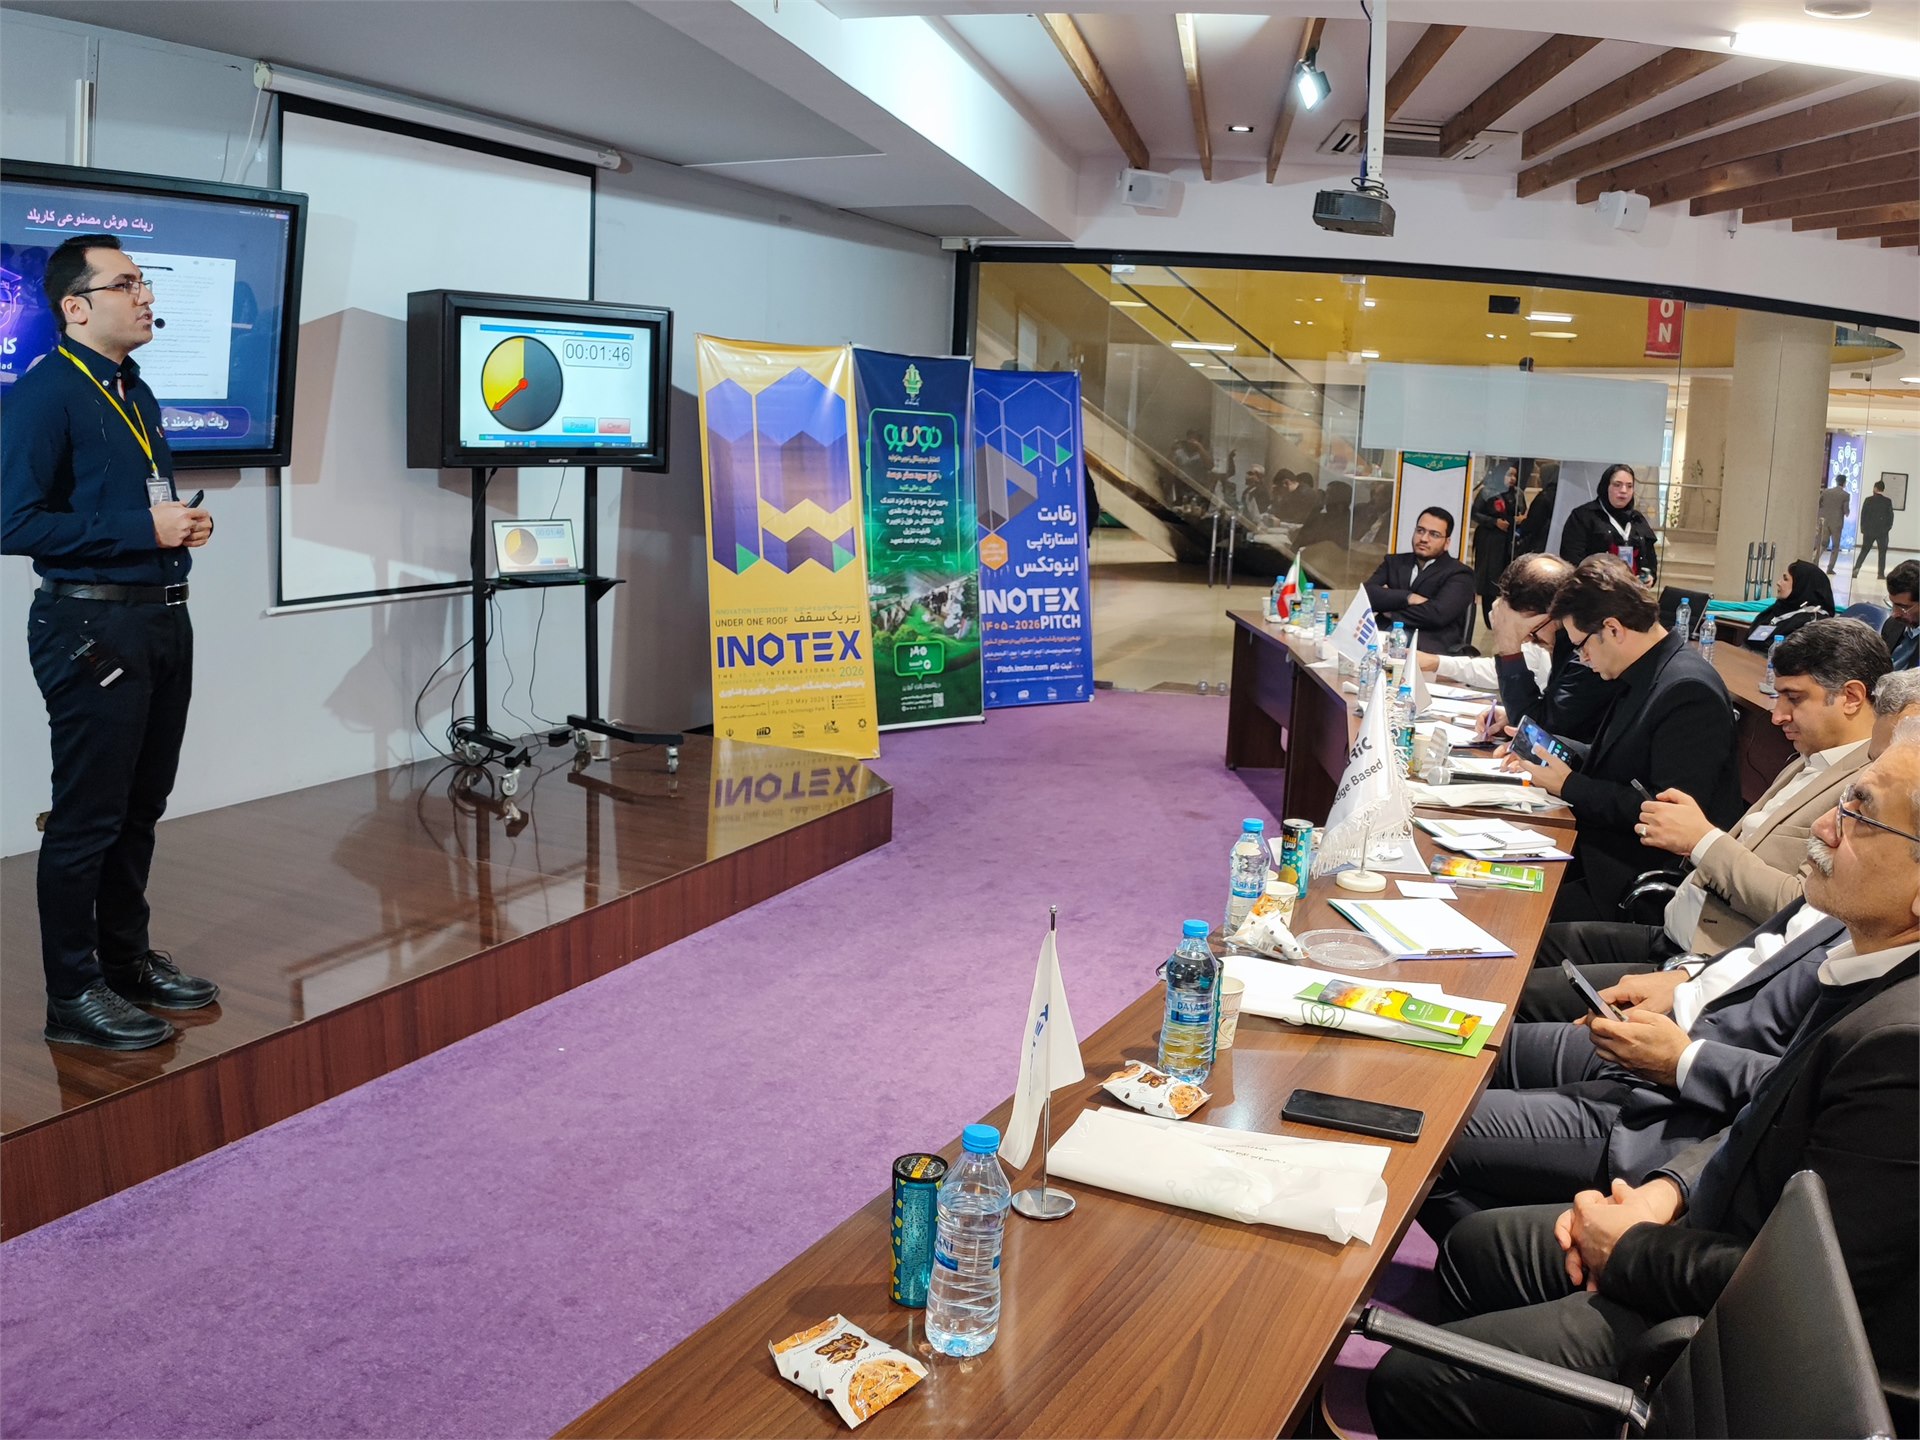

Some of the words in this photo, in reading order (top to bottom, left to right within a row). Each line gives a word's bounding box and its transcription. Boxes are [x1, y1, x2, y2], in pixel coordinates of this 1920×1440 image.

[57, 212, 101, 227] مصنوعی
[103, 214, 128, 230] هوش
[565, 343, 631, 362] 00:01:46
[171, 415, 204, 430] هوشمند
[1037, 504, 1077, 525] رقابت
[1026, 532, 1078, 552] استارتاپی
[1015, 556, 1079, 577] اینوتکس
[980, 587, 1080, 615] INOTEX
[715, 618, 744, 627] UNDER
[746, 617, 763, 626] ONE
[766, 616, 788, 625] ROOF
[794, 610, 825, 623] سقف
[827, 611, 844, 624] یک
[845, 612, 861, 624] زیر
[1040, 614, 1081, 630] PITCH
[716, 630, 862, 668] INOTEX
[766, 668, 835, 677] INTERNATIONAL
[839, 666, 864, 677] 2026
[1350, 758, 1383, 786] Based
